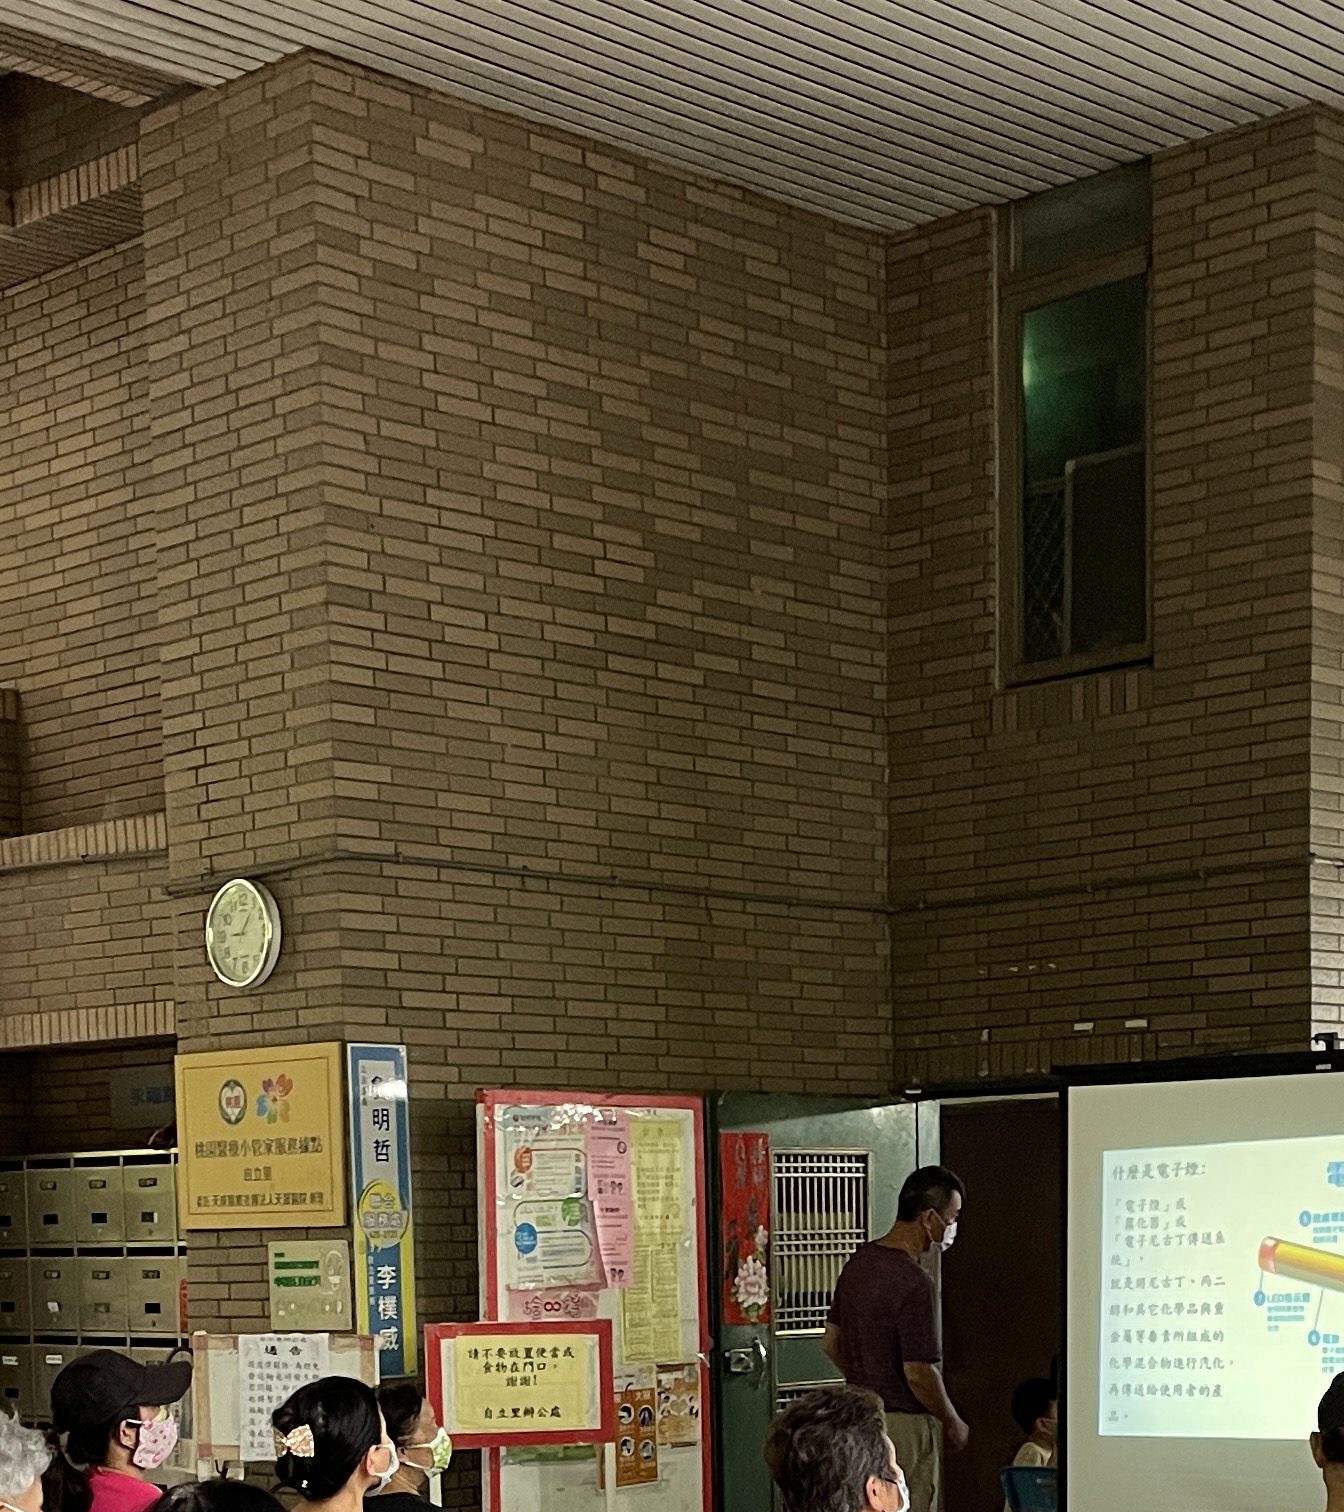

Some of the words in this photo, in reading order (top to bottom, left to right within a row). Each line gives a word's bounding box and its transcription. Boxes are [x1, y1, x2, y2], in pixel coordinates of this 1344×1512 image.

[468, 1346, 575, 1360] 請不要放置便當或
[484, 1406, 561, 1419] 自立里辦公處
